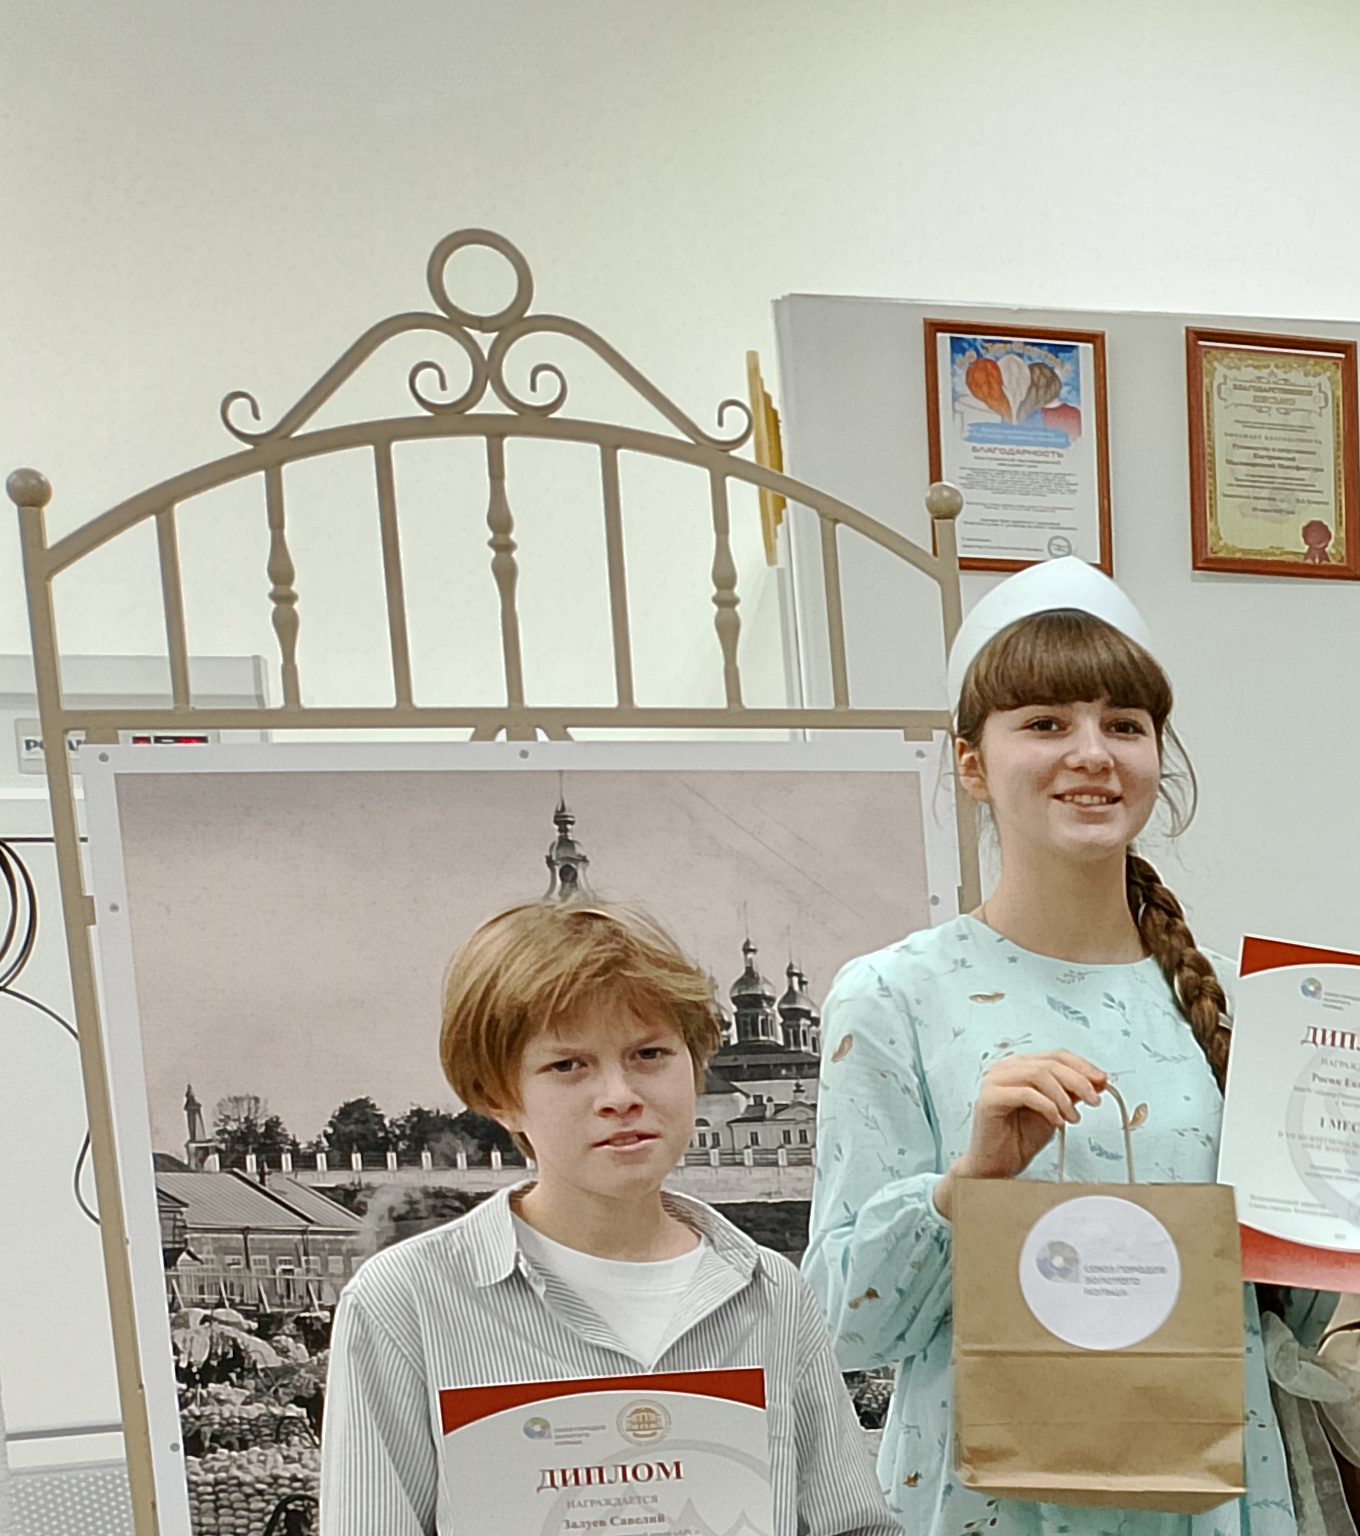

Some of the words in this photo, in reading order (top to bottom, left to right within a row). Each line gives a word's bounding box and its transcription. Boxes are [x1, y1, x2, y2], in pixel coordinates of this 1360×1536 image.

[1320, 1117, 1325, 1128] I
[536, 1461, 685, 1494] ДИПЛОМ
[566, 1495, 658, 1510] НАГРАЖДАЕТСЯ
[563, 1518, 607, 1532] Залуев
[609, 1513, 665, 1527] Савелий
